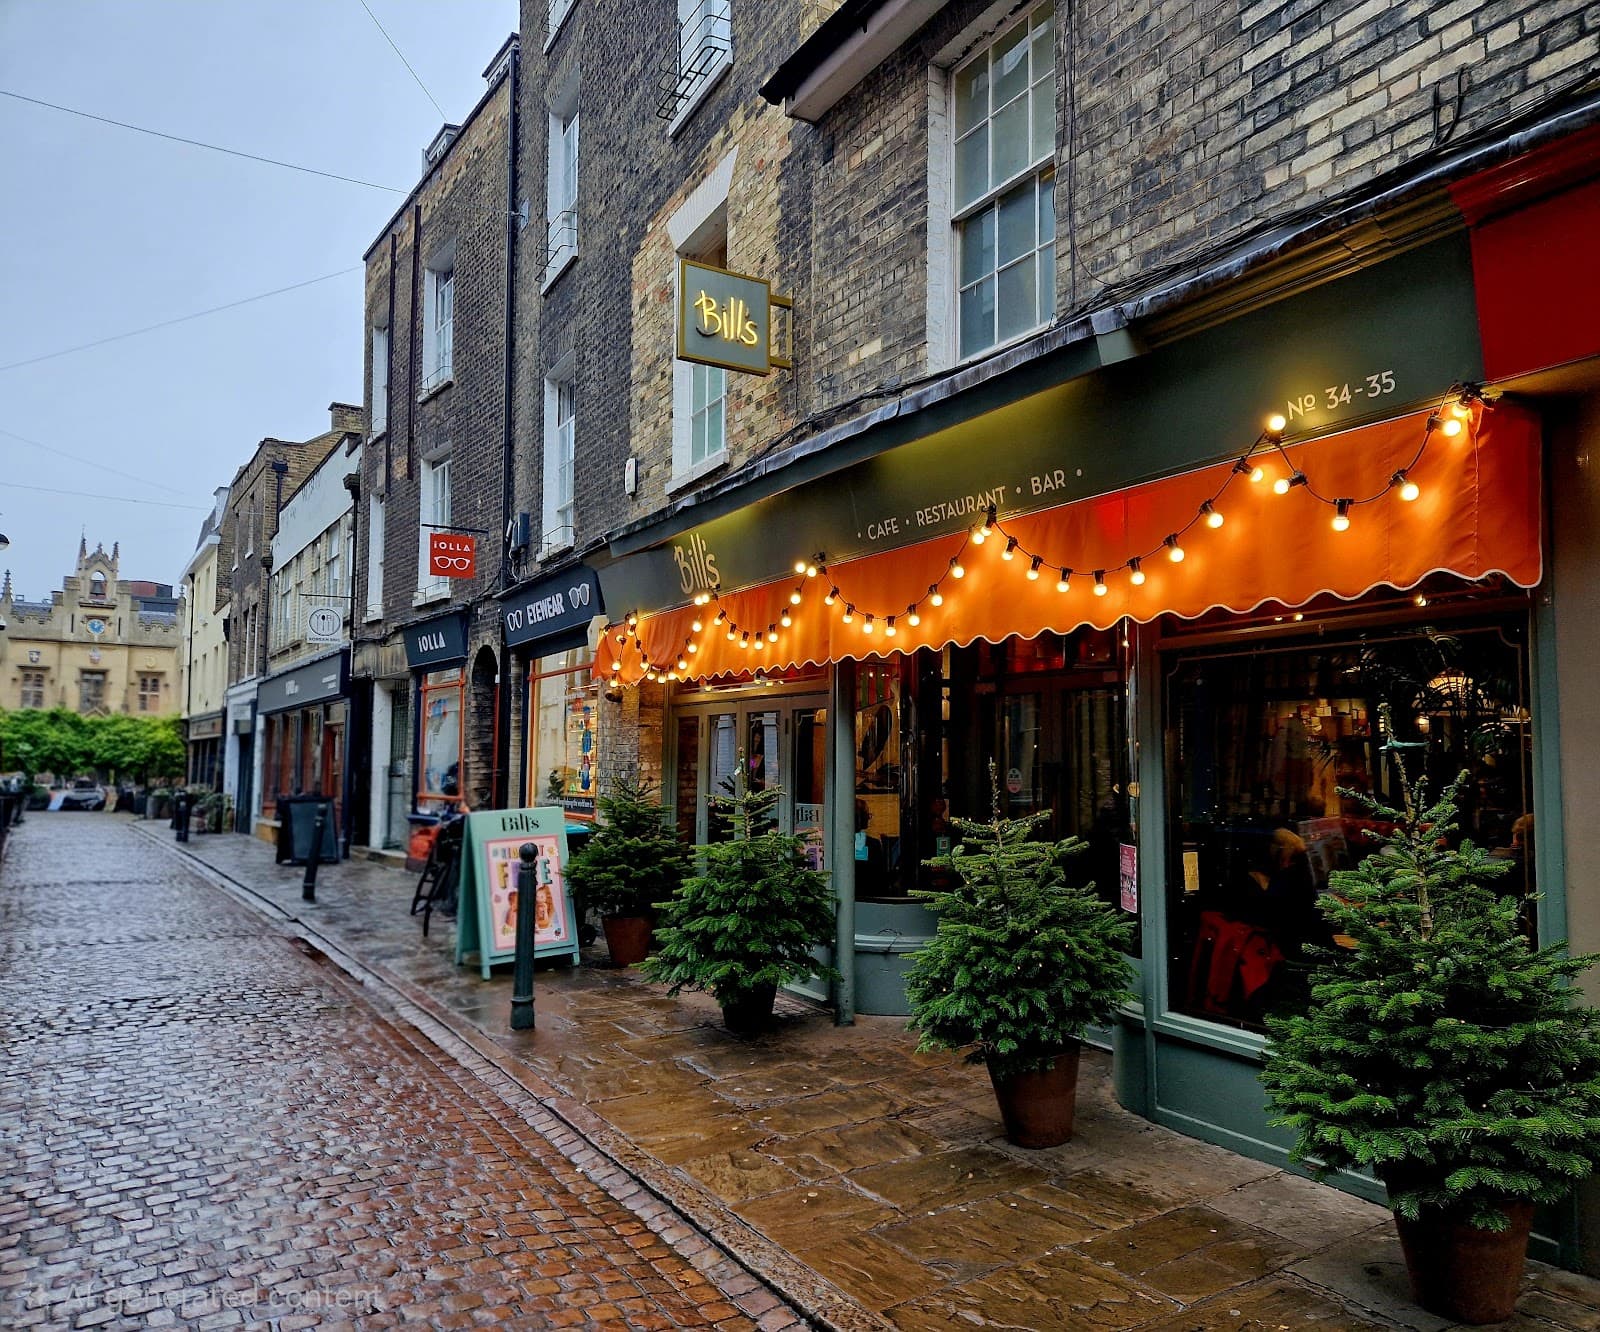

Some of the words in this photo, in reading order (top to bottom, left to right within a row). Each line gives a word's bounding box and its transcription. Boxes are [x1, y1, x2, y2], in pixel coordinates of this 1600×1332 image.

[694, 289, 758, 345] Bill's
[1325, 370, 1396, 409] 34-35
[867, 517, 900, 540] CAFE
[915, 485, 1006, 527] RESTAURANT
[1030, 469, 1066, 495] BAR
[673, 532, 721, 594] Bill's
[526, 592, 565, 625] EYEWEAR
[501, 812, 540, 832] Bill's
